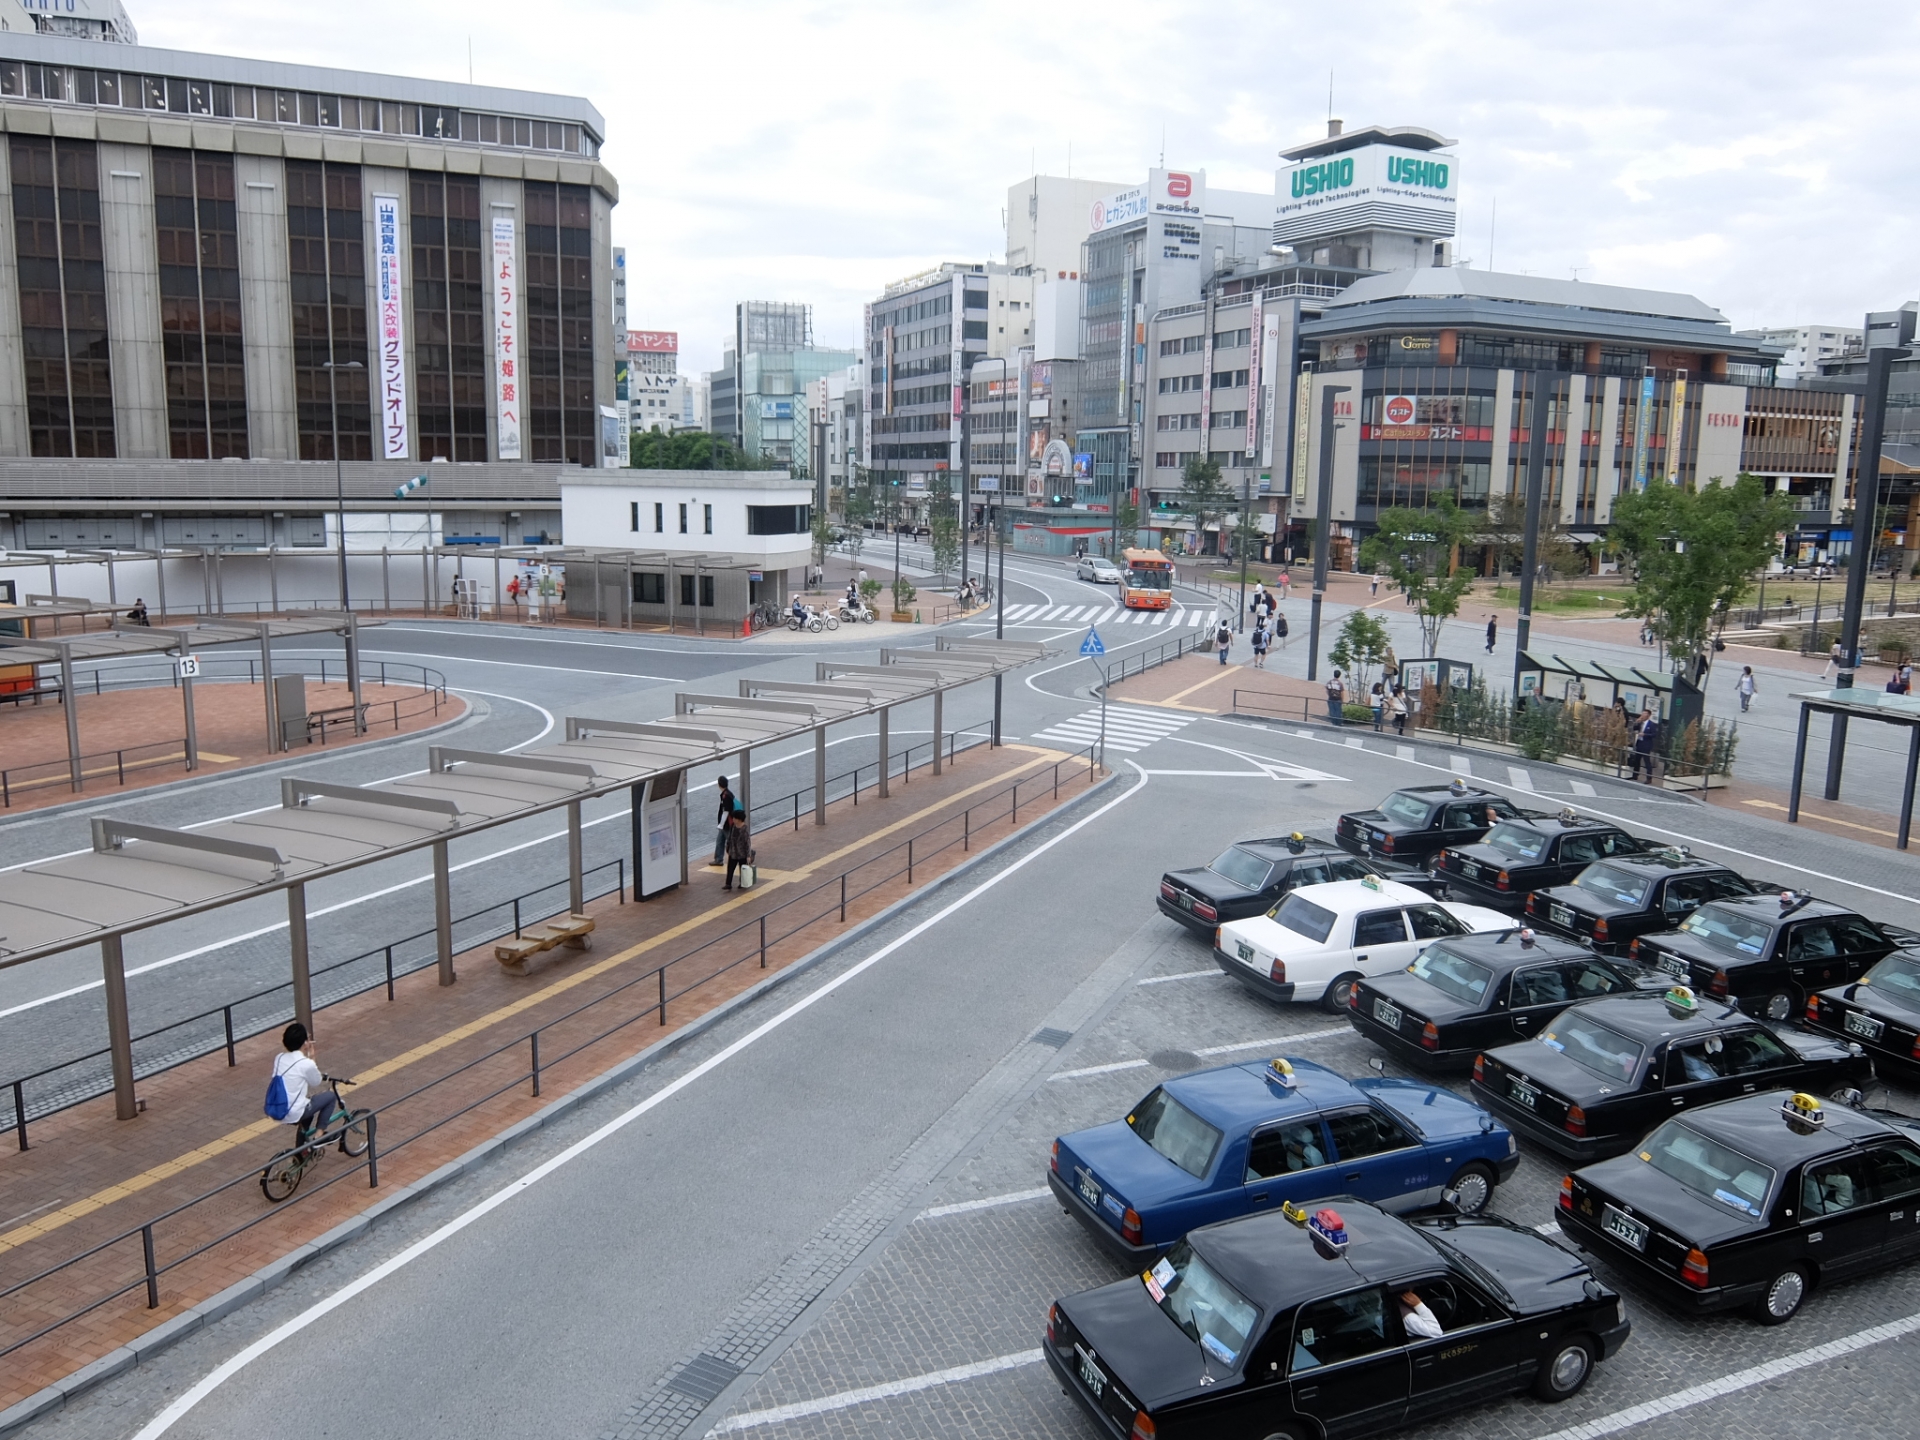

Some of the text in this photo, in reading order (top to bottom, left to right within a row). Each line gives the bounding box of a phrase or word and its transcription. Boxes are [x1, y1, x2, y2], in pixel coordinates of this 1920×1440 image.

[1291, 157, 1354, 198] USHIO
[1388, 155, 1449, 189] USHIO
[1325, 187, 1370, 202] Technologies
[1106, 200, 1139, 224] ヒガシマル
[380, 204, 395, 255] 山陽百貨店
[384, 301, 398, 339] 大改装
[615, 278, 627, 345] 神姫バス
[500, 261, 517, 424] ようこそ姫路へ
[384, 340, 405, 454] グランドオープン
[1333, 401, 1352, 416] STA
[1390, 408, 1411, 416] ガスト
[1707, 412, 1740, 428] FESTA
[618, 406, 628, 461] 三井住友銀行
[1429, 426, 1462, 439] ガスト
[541, 567, 547, 575] 6
[182, 660, 196, 674] 13
[1615, 1223, 1640, 1243] 19-78
[1440, 1344, 1479, 1360] はくろタクシー
[1084, 1367, 1102, 1396] 13-15
